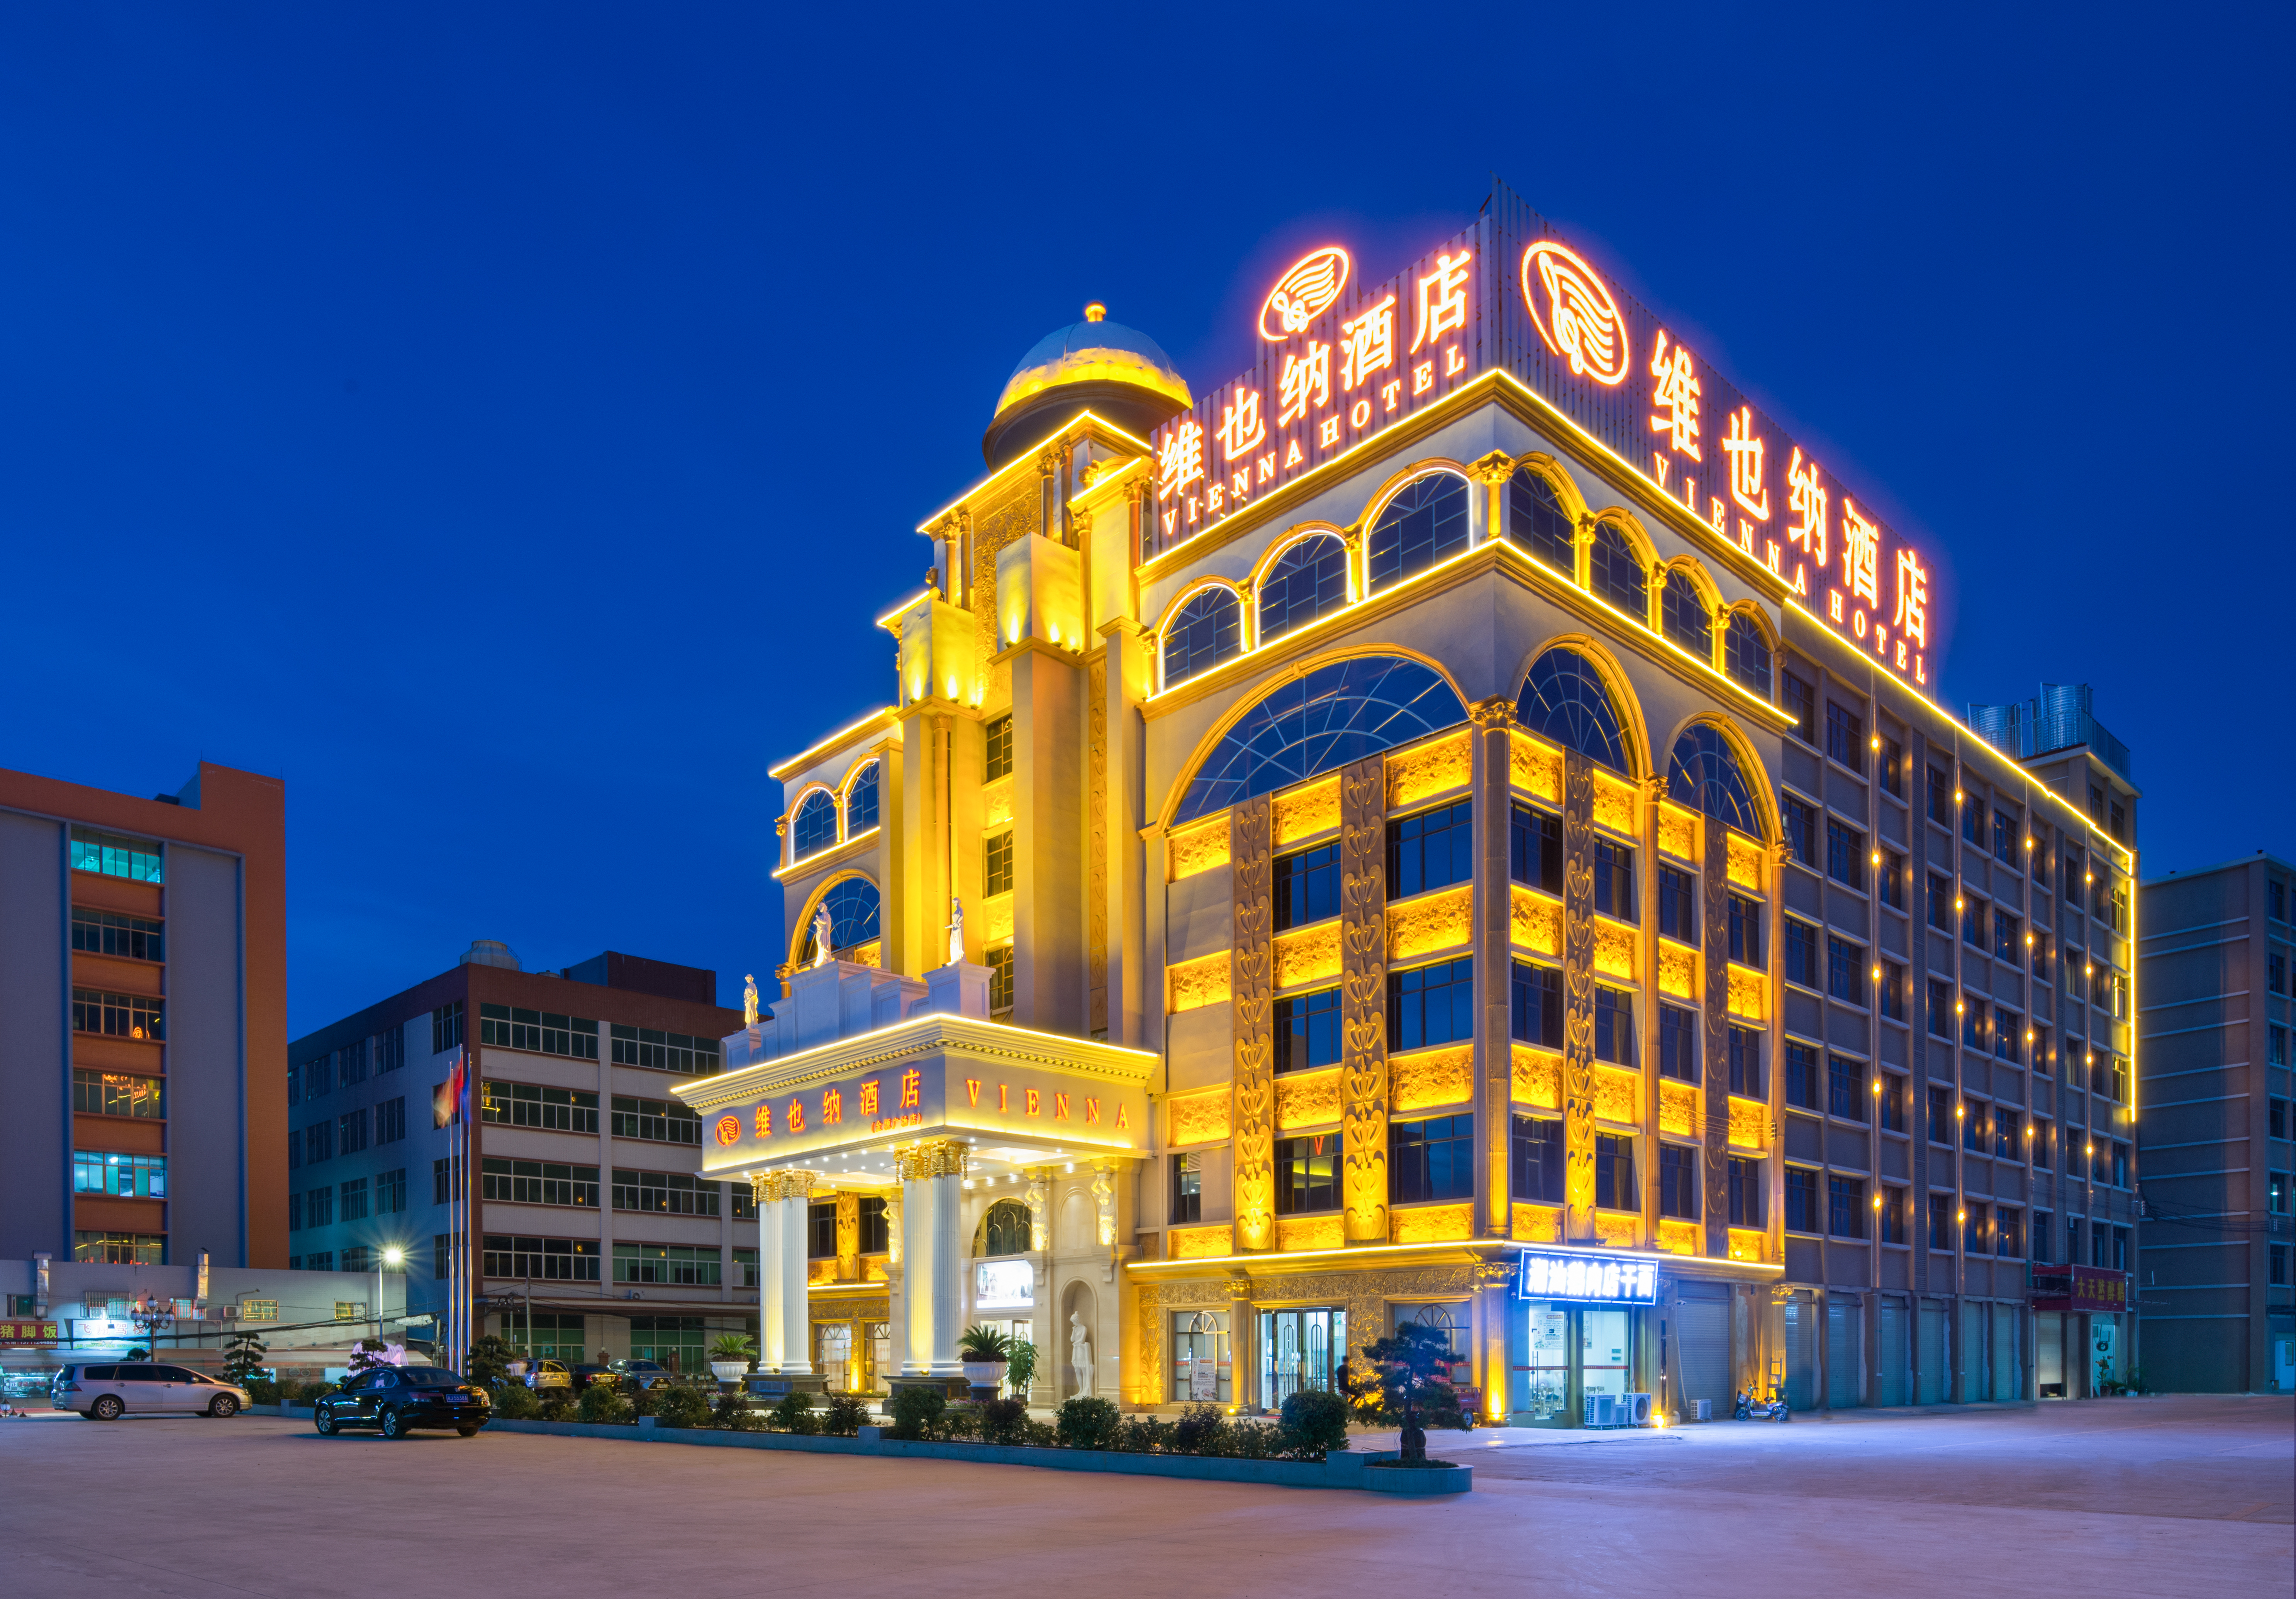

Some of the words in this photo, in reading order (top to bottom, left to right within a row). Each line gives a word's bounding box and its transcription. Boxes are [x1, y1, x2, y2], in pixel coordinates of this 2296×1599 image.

[1159, 250, 1471, 500] 维也纳酒店
[1163, 440, 1303, 534] VIENNA
[1320, 345, 1464, 448] HOTEL
[1651, 329, 1926, 649] 维也纳酒店
[1654, 452, 1806, 595] VIENNA
[1830, 589, 1925, 684] HOTEL
[755, 1069, 921, 1138] 维也纳酒店
[966, 1079, 1130, 1130] VIENNA
[0, 1325, 57, 1338] 猪脚饭
